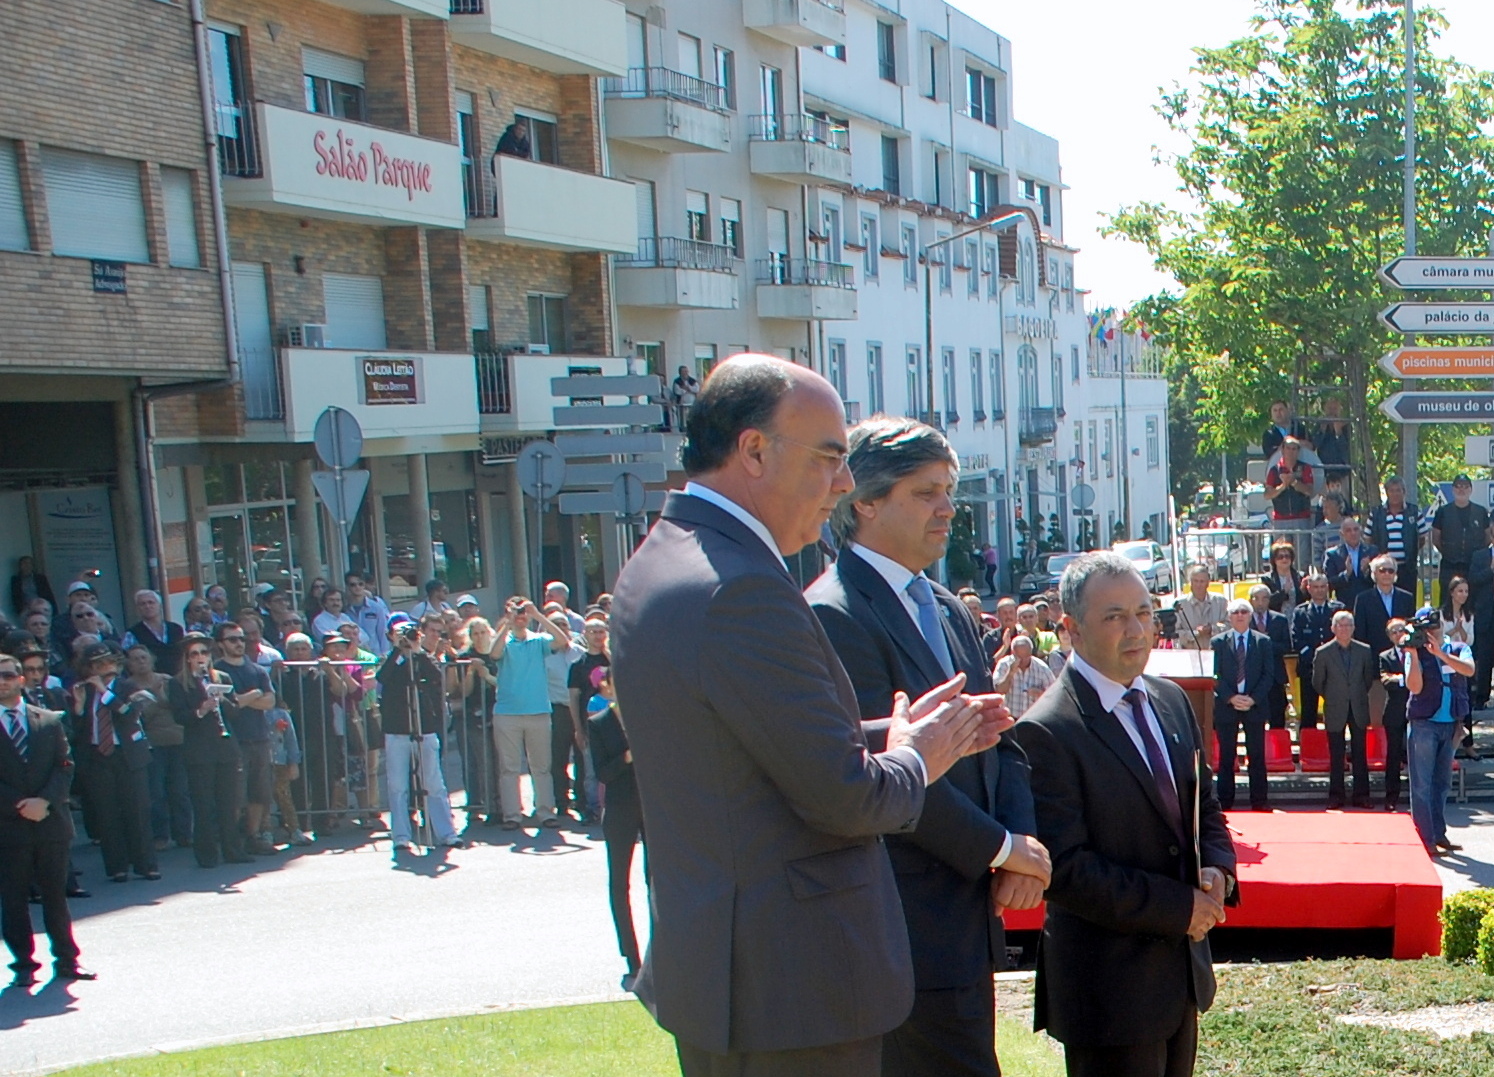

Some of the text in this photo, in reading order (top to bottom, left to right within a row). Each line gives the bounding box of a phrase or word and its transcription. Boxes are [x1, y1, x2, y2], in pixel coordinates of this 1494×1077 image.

[313, 128, 433, 202] Salão Parque
[1422, 265, 1469, 277] câmara
[1425, 310, 1469, 324] palácio
[1474, 310, 1489, 322] da
[1402, 355, 1450, 369] piscinas
[1418, 401, 1461, 412] museu
[1464, 400, 1480, 412] de
